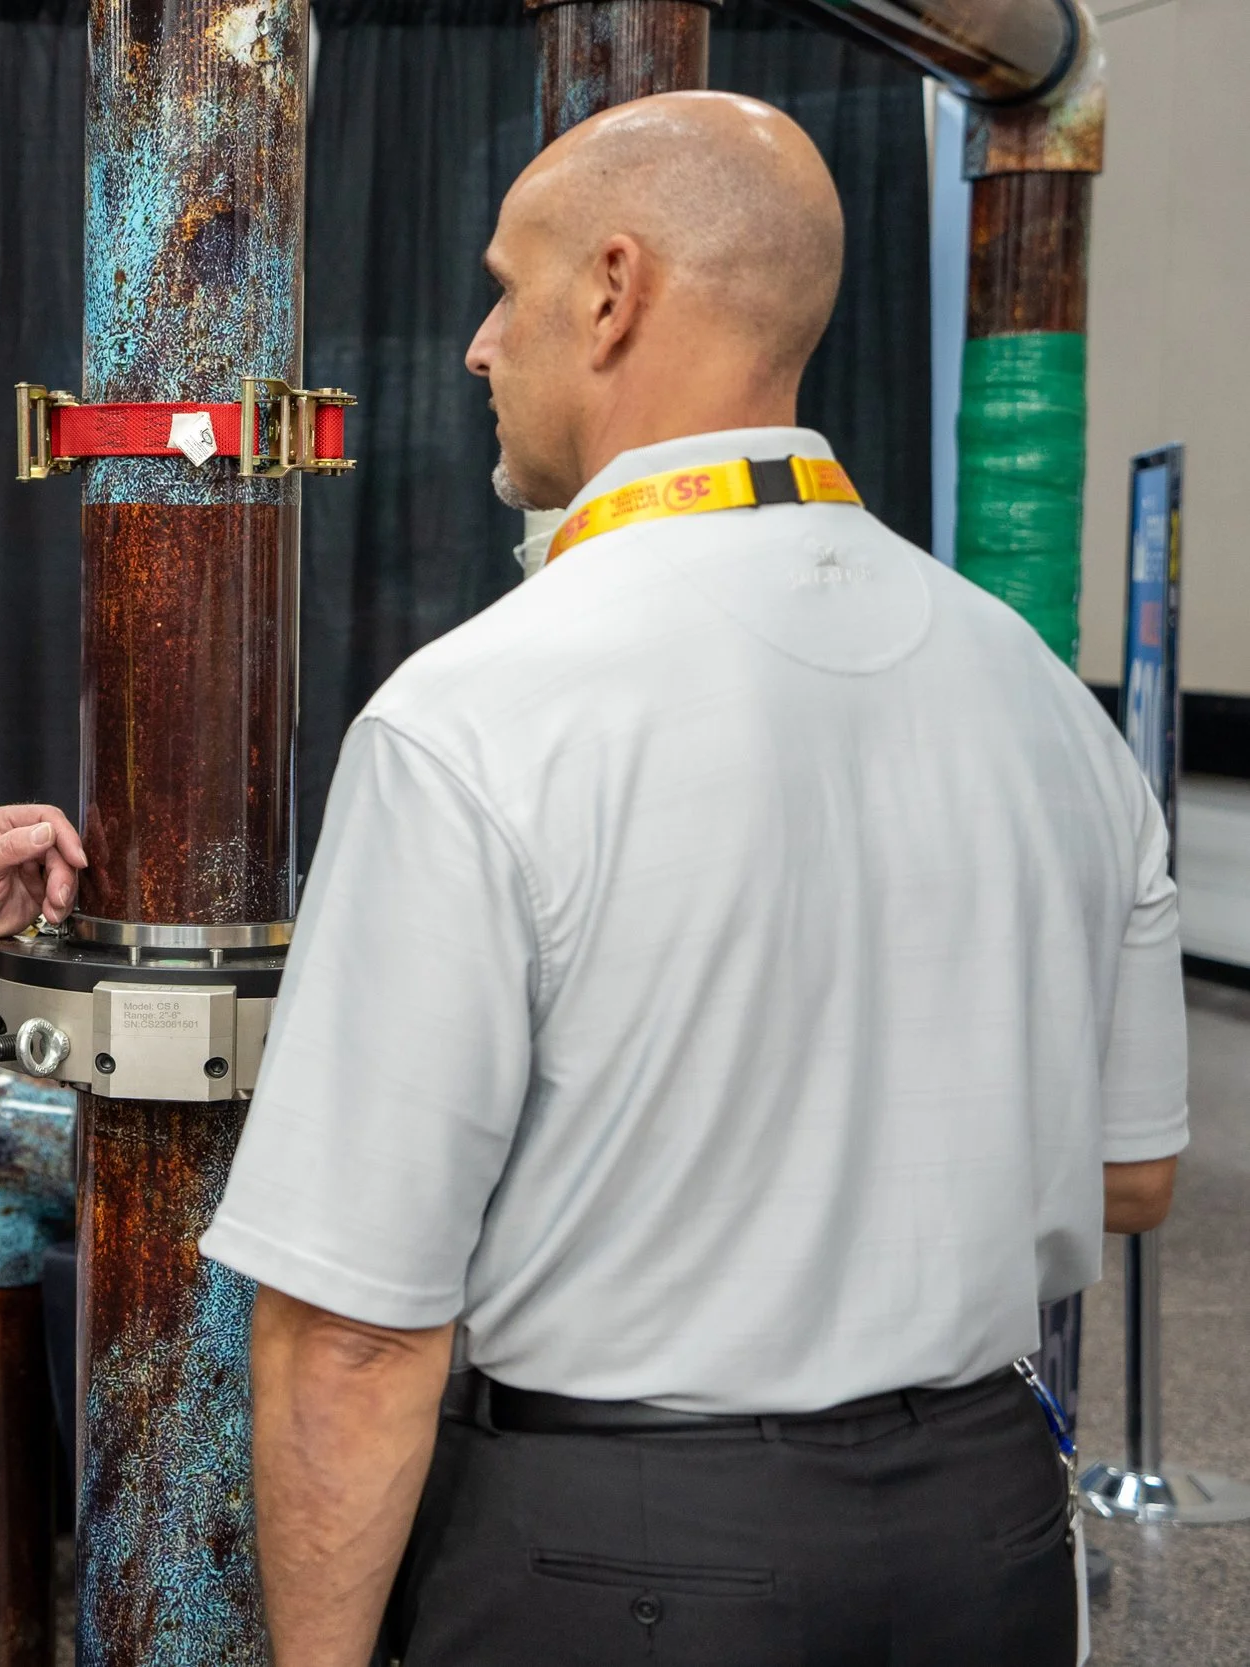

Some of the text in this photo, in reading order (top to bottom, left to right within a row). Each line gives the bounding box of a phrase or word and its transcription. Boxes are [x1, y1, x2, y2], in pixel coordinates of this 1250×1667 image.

[674, 474, 711, 501] 3S
[124, 1002, 153, 1011] Model:
[157, 1002, 171, 1011] CS
[124, 1011, 156, 1021] Range:
